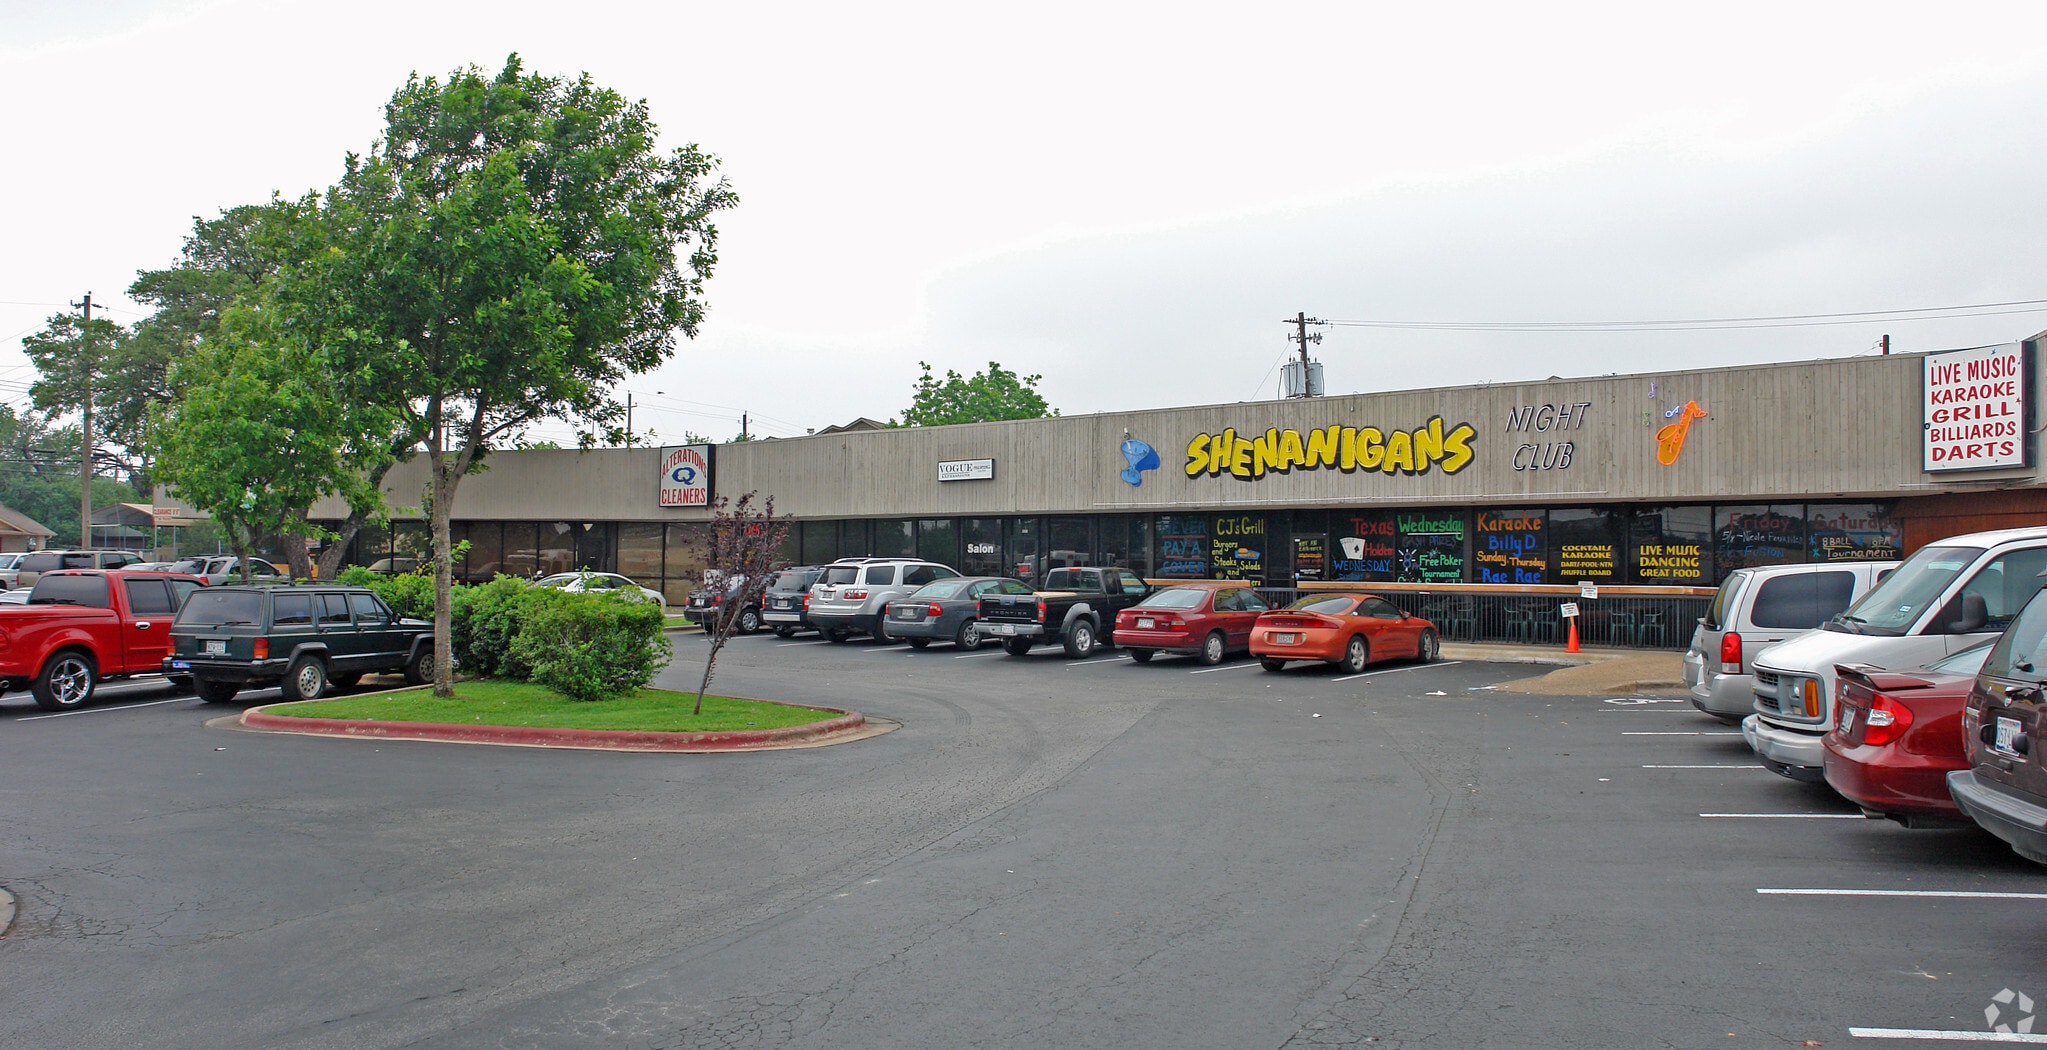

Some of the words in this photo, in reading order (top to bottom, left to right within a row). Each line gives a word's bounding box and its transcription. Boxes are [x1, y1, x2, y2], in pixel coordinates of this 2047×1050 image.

[1930, 362, 1962, 387] LIVE
[1967, 354, 2017, 382] MUSIC
[1930, 380, 2016, 405] KARAOKE
[1505, 402, 1591, 433] NIGHT
[1931, 401, 2016, 424] GRILL
[1929, 420, 2017, 443] BILLIARDS
[1184, 415, 1478, 482] SHENANIGANS
[1512, 441, 1575, 471] CLUB
[1930, 440, 2015, 462] DARTS
[661, 448, 707, 479] ALTERATIONS
[939, 463, 973, 474] VOGUE
[671, 466, 697, 486] Q
[661, 487, 706, 505] CLEANERS
[1216, 518, 1240, 536] CJ's
[1241, 516, 1264, 535] Grill
[1350, 517, 1395, 537] Texas
[1397, 514, 1464, 541] Wednesday
[1477, 511, 1542, 532] Karaoke
[1729, 512, 1791, 531] Friday
[1813, 511, 1903, 538] Saturday
[967, 544, 994, 554] Salon
[1163, 540, 1188, 557] PAY
[1191, 541, 1201, 556] A
[1213, 539, 1238, 552] Burgers
[1488, 534, 1522, 558] Billy
[1524, 533, 1536, 550] D
[1561, 544, 1613, 552] COCKTAILS
[1640, 545, 1663, 556] LIVE
[1667, 545, 1700, 556] MUSIC
[1162, 560, 1206, 573] COVER
[1240, 560, 1262, 571] Salads
[1334, 560, 1391, 572] WEDNESDAY
[1419, 554, 1439, 567] Free
[1440, 554, 1464, 567] Poker
[1639, 557, 1700, 567] DANCING
[1419, 567, 1462, 579] Tournament
[1482, 567, 1508, 584] Rae
[1515, 567, 1542, 584] Rae
[1560, 569, 1588, 577] SHUFFLE
[1588, 569, 1613, 577] BOARD
[1639, 568, 1670, 578] GREAT
[1673, 568, 1702, 578] FOOD
